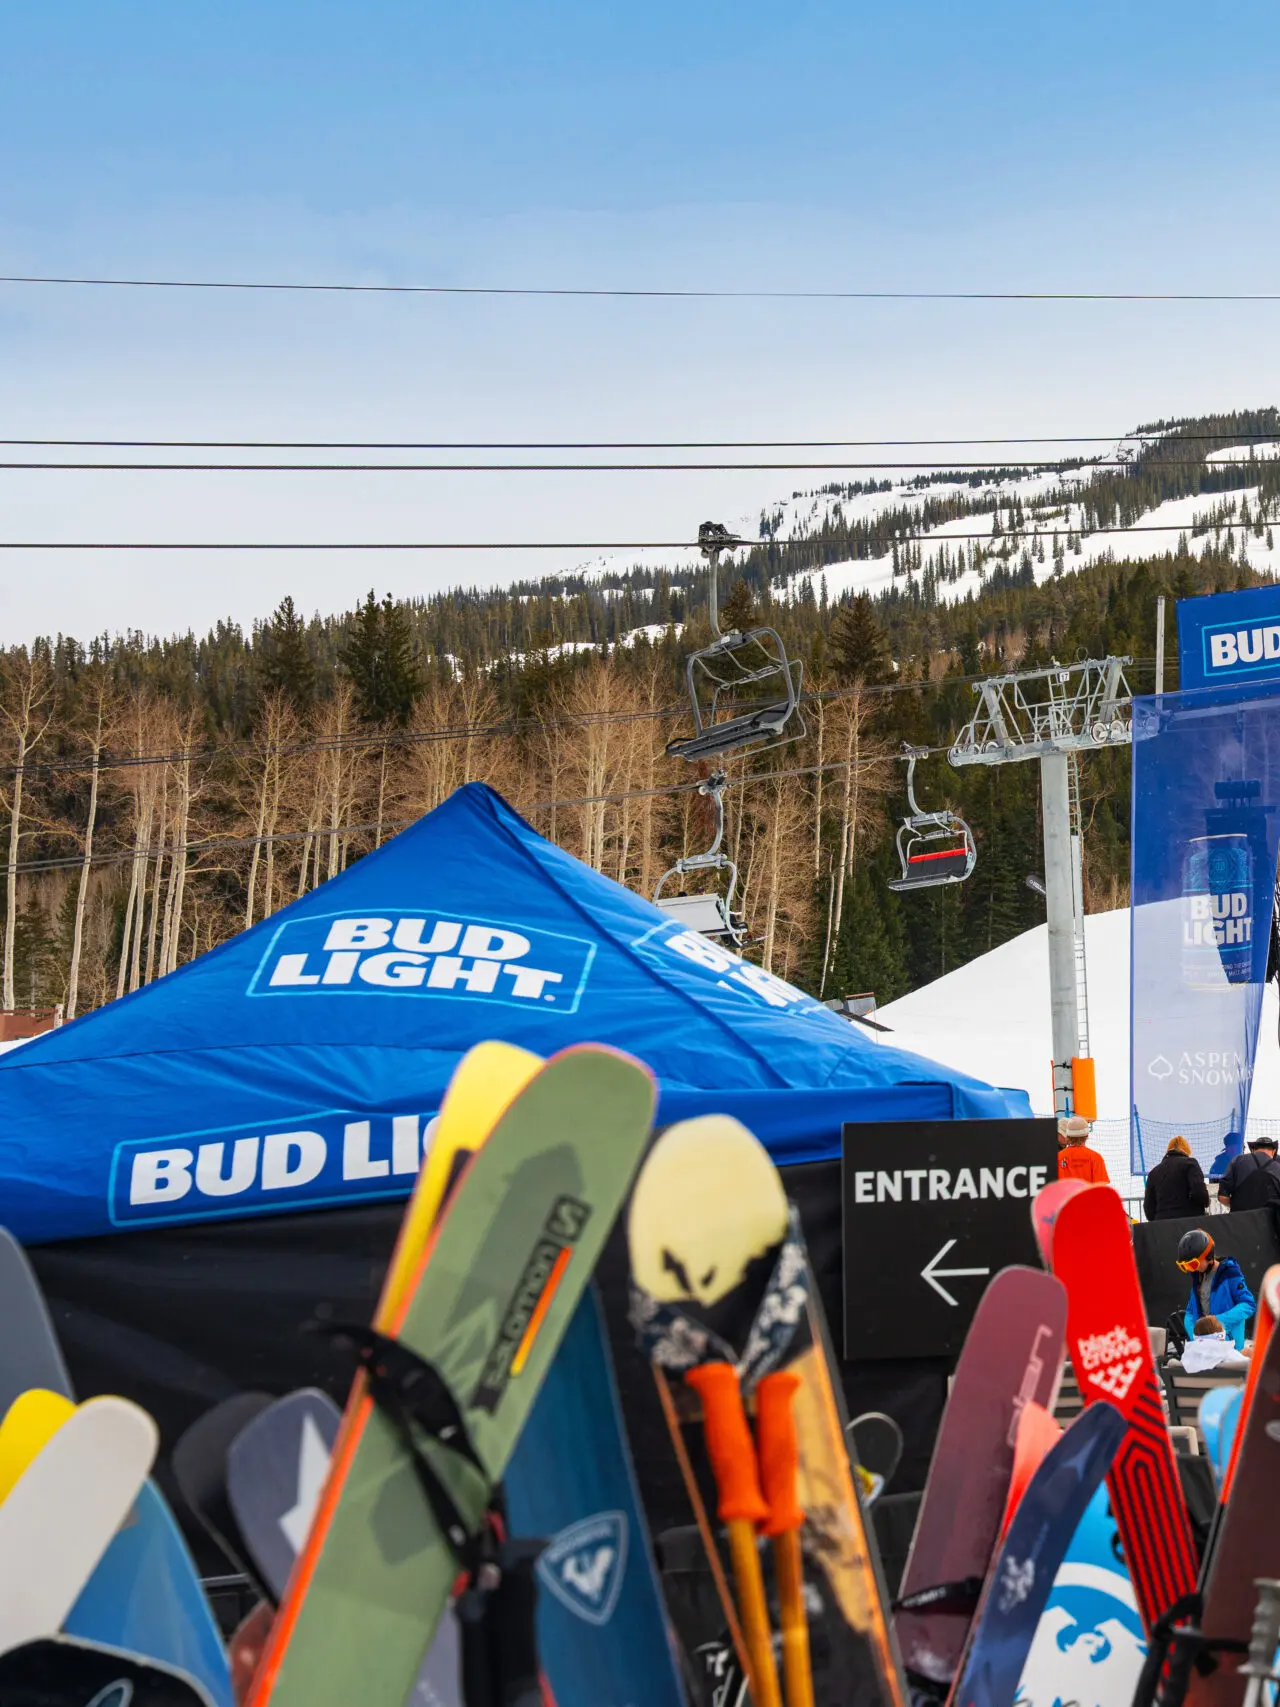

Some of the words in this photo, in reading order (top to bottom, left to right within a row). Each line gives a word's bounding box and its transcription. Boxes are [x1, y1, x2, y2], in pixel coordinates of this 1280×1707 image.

[1191, 893, 1247, 920] BUD
[323, 918, 531, 960] BUD
[1184, 917, 1252, 946] LIGHT
[269, 951, 562, 998] LIGHT
[1179, 1051, 1241, 1068] ASPEN
[129, 1131, 327, 1204] BUD
[854, 1165, 1048, 1203] ENTRANCE
